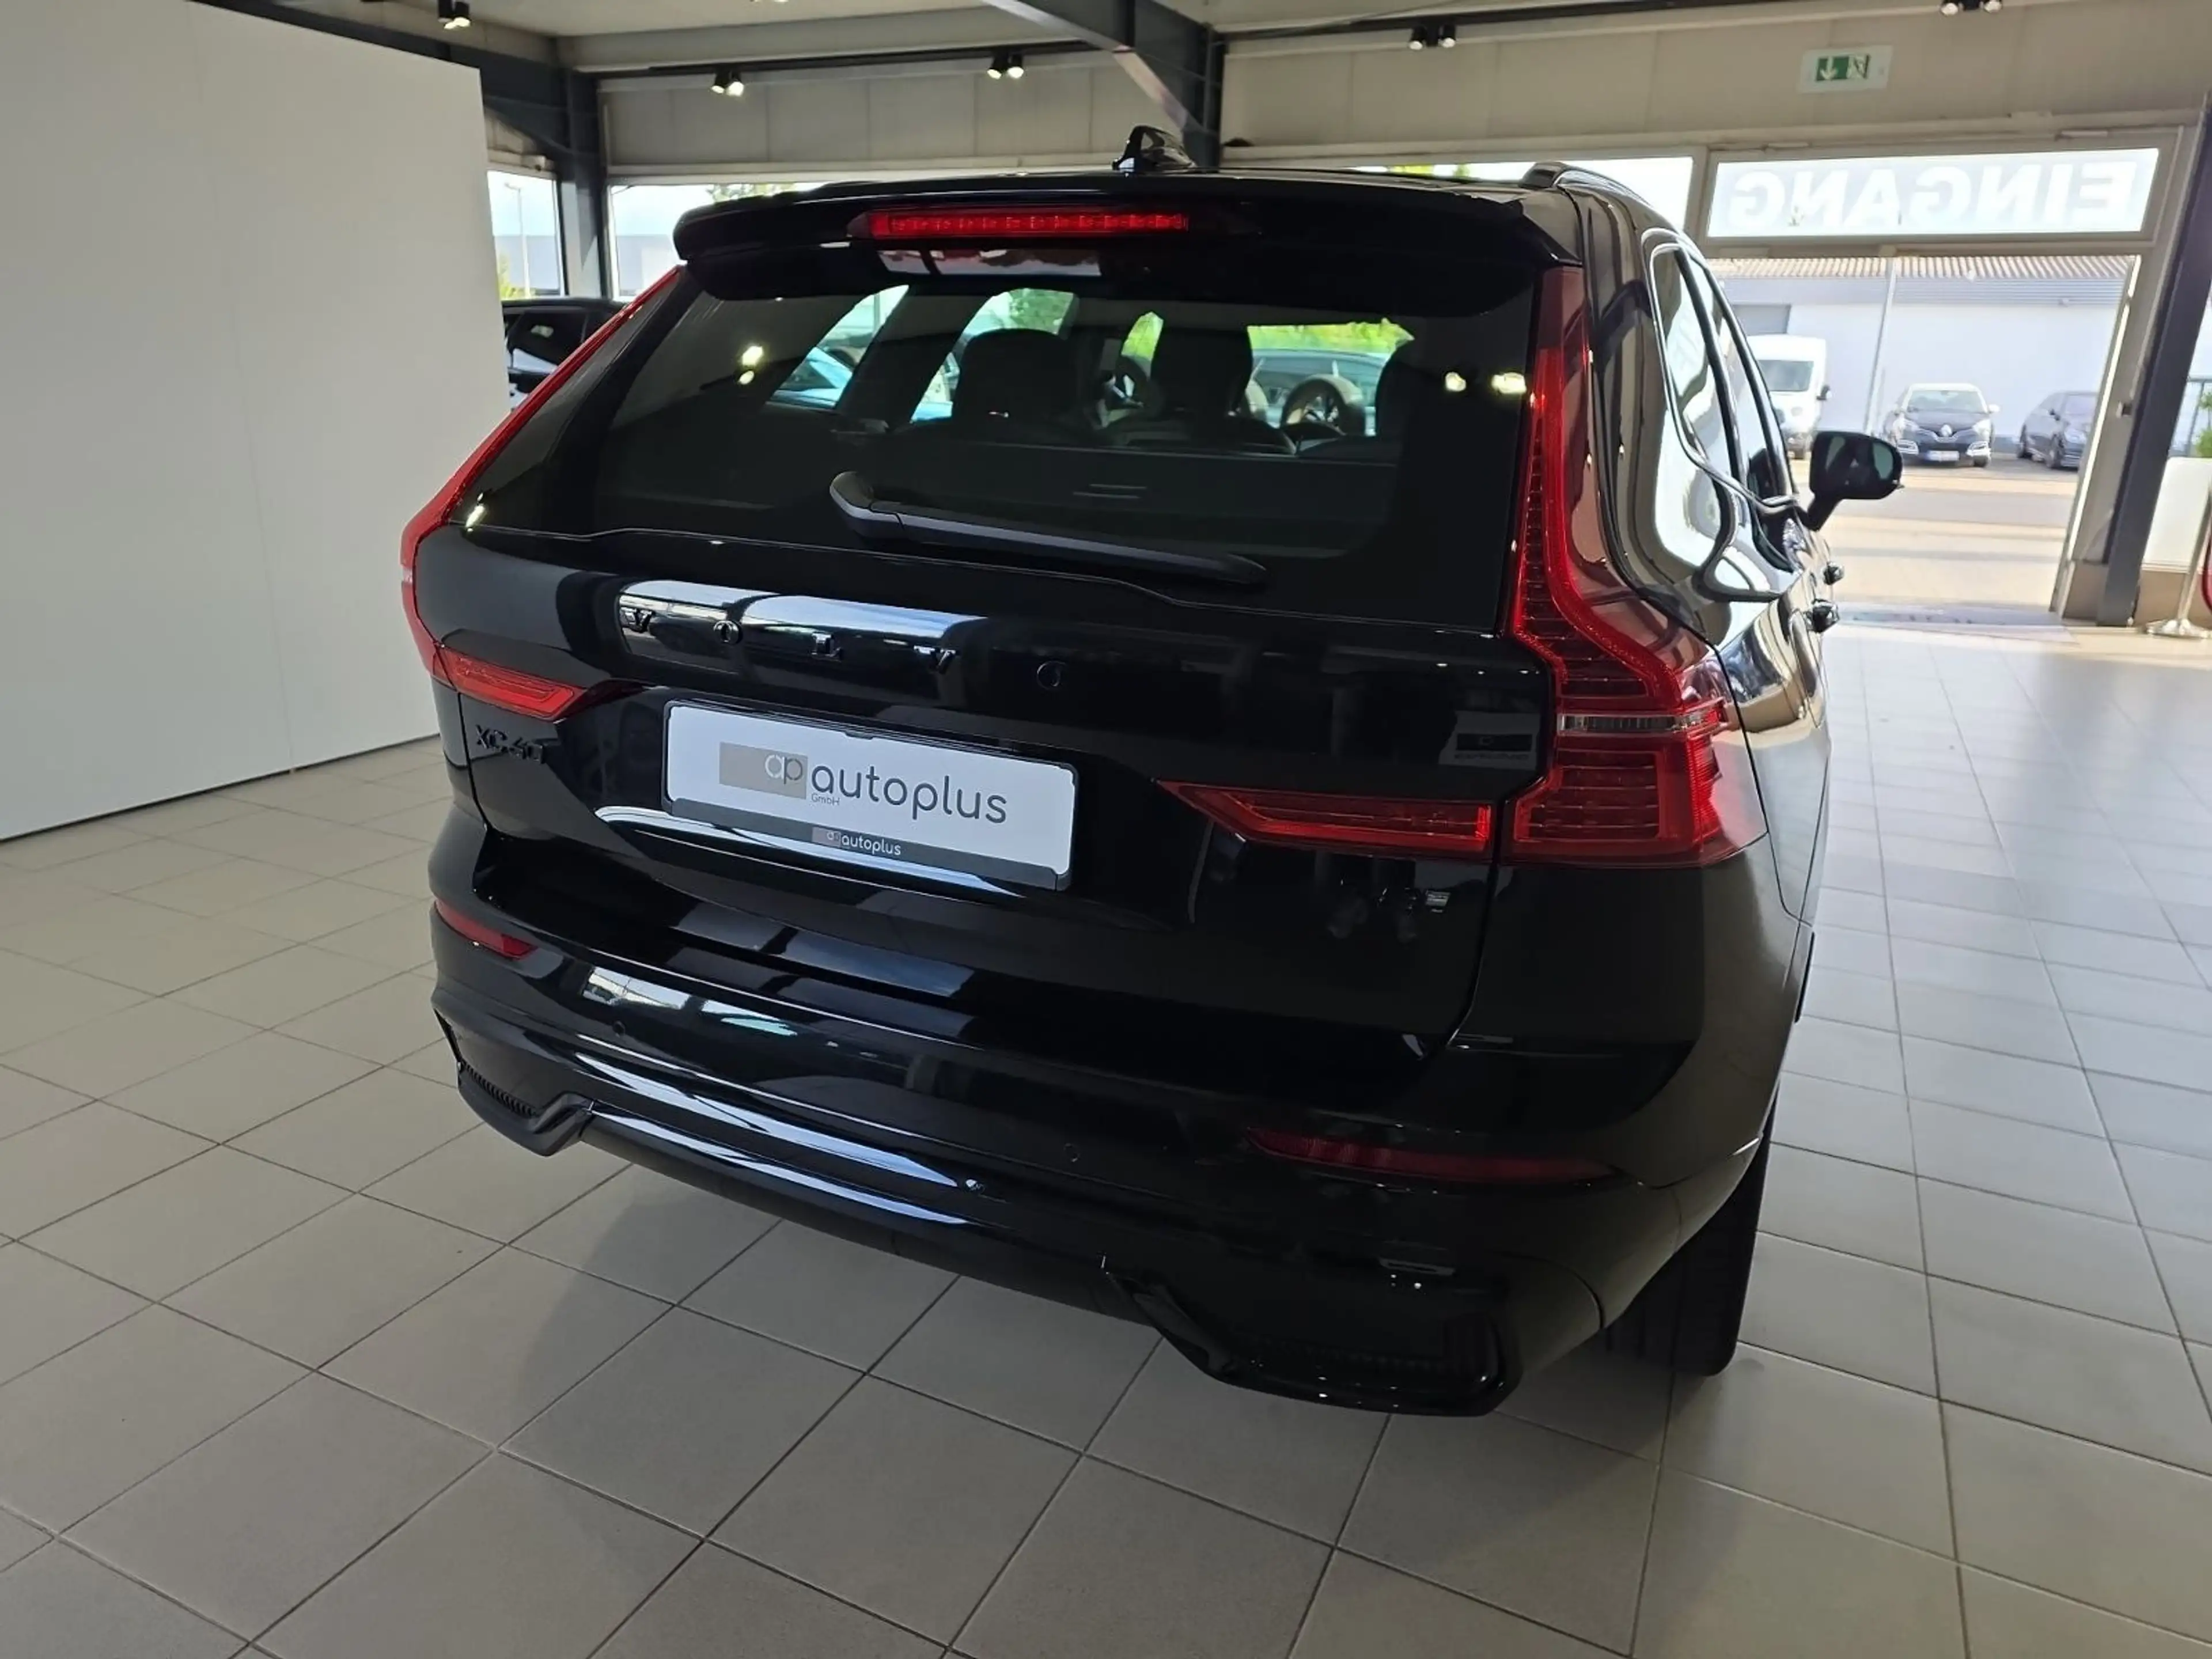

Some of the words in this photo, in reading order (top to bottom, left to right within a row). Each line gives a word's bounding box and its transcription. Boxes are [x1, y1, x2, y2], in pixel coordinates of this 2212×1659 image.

[811, 793, 840, 805] GmbH
[812, 766, 1007, 823] autoplus
[842, 835, 901, 855] autoplus
